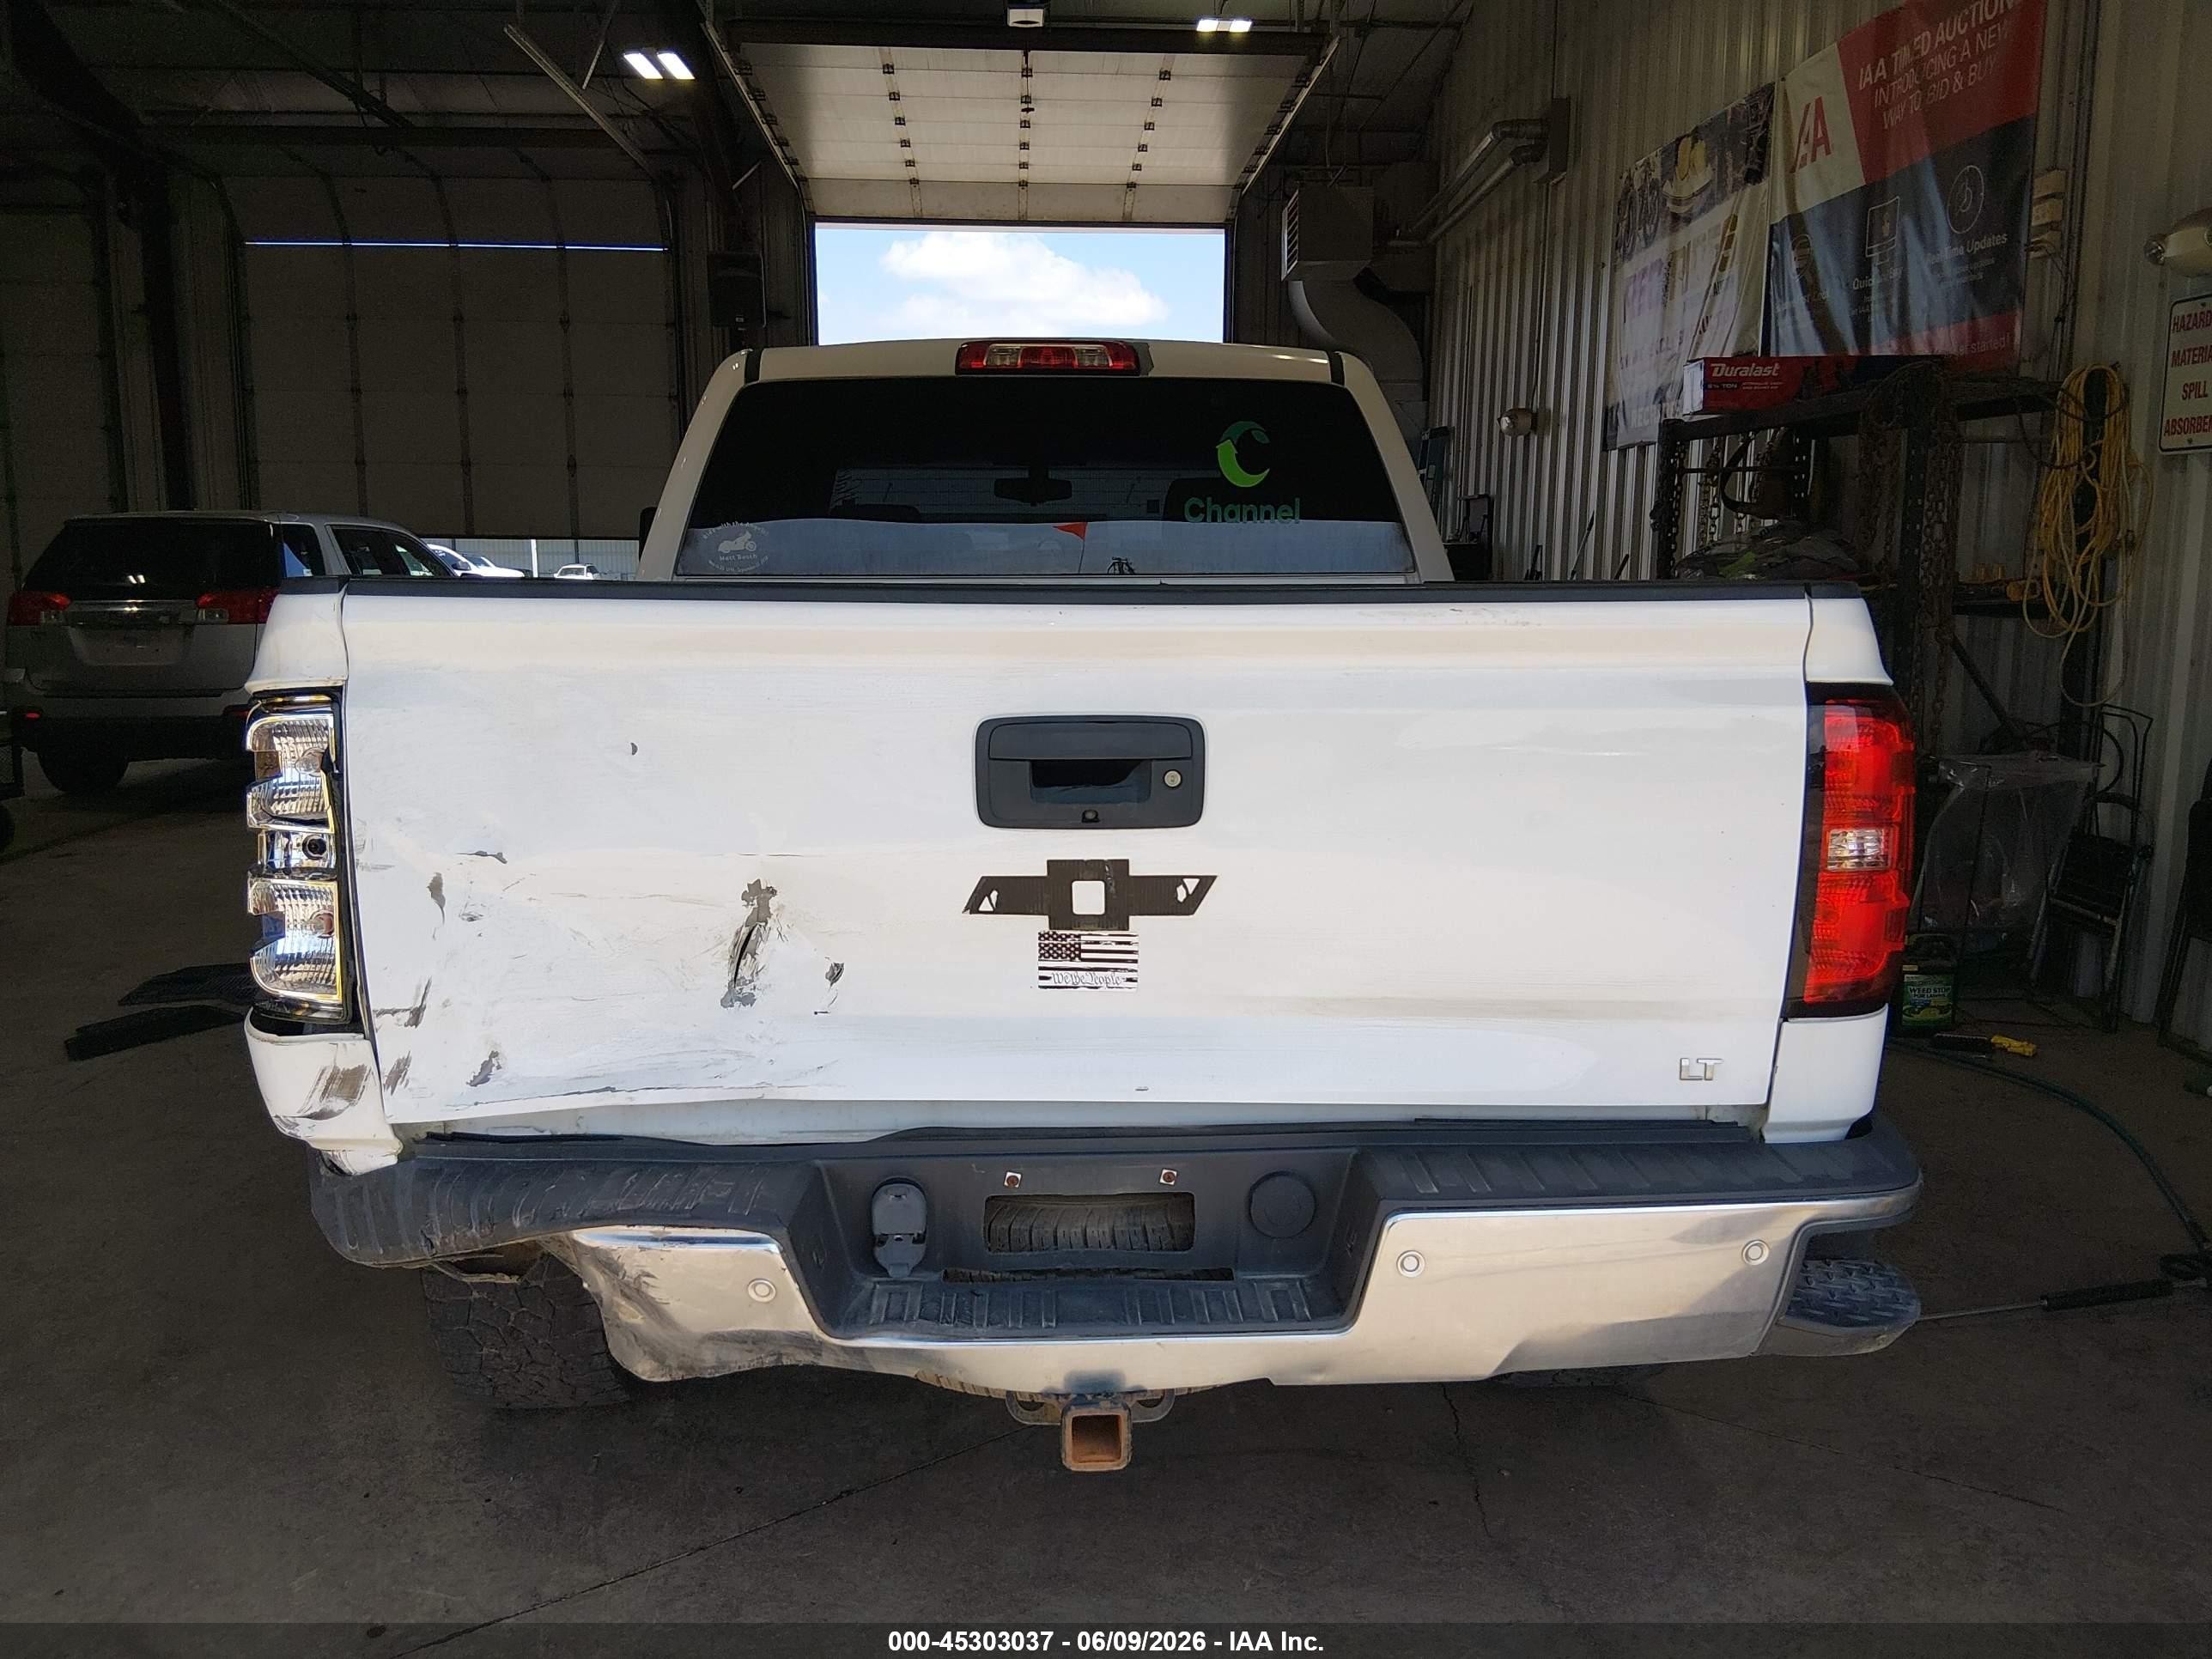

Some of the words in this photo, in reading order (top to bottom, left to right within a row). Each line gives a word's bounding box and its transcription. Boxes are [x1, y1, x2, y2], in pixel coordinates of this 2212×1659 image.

[1960, 39, 1972, 63] A
[1859, 57, 1887, 90] IAA
[1909, 90, 1922, 113] TO
[1953, 70, 1964, 93] &
[1966, 233, 2008, 254] Updates
[2172, 309, 2212, 333] HAZARD
[1711, 362, 1781, 378] Duralast
[2182, 380, 2208, 400] SPILL
[1183, 496, 1300, 524] Channel
[1680, 1057, 1723, 1081] LT
